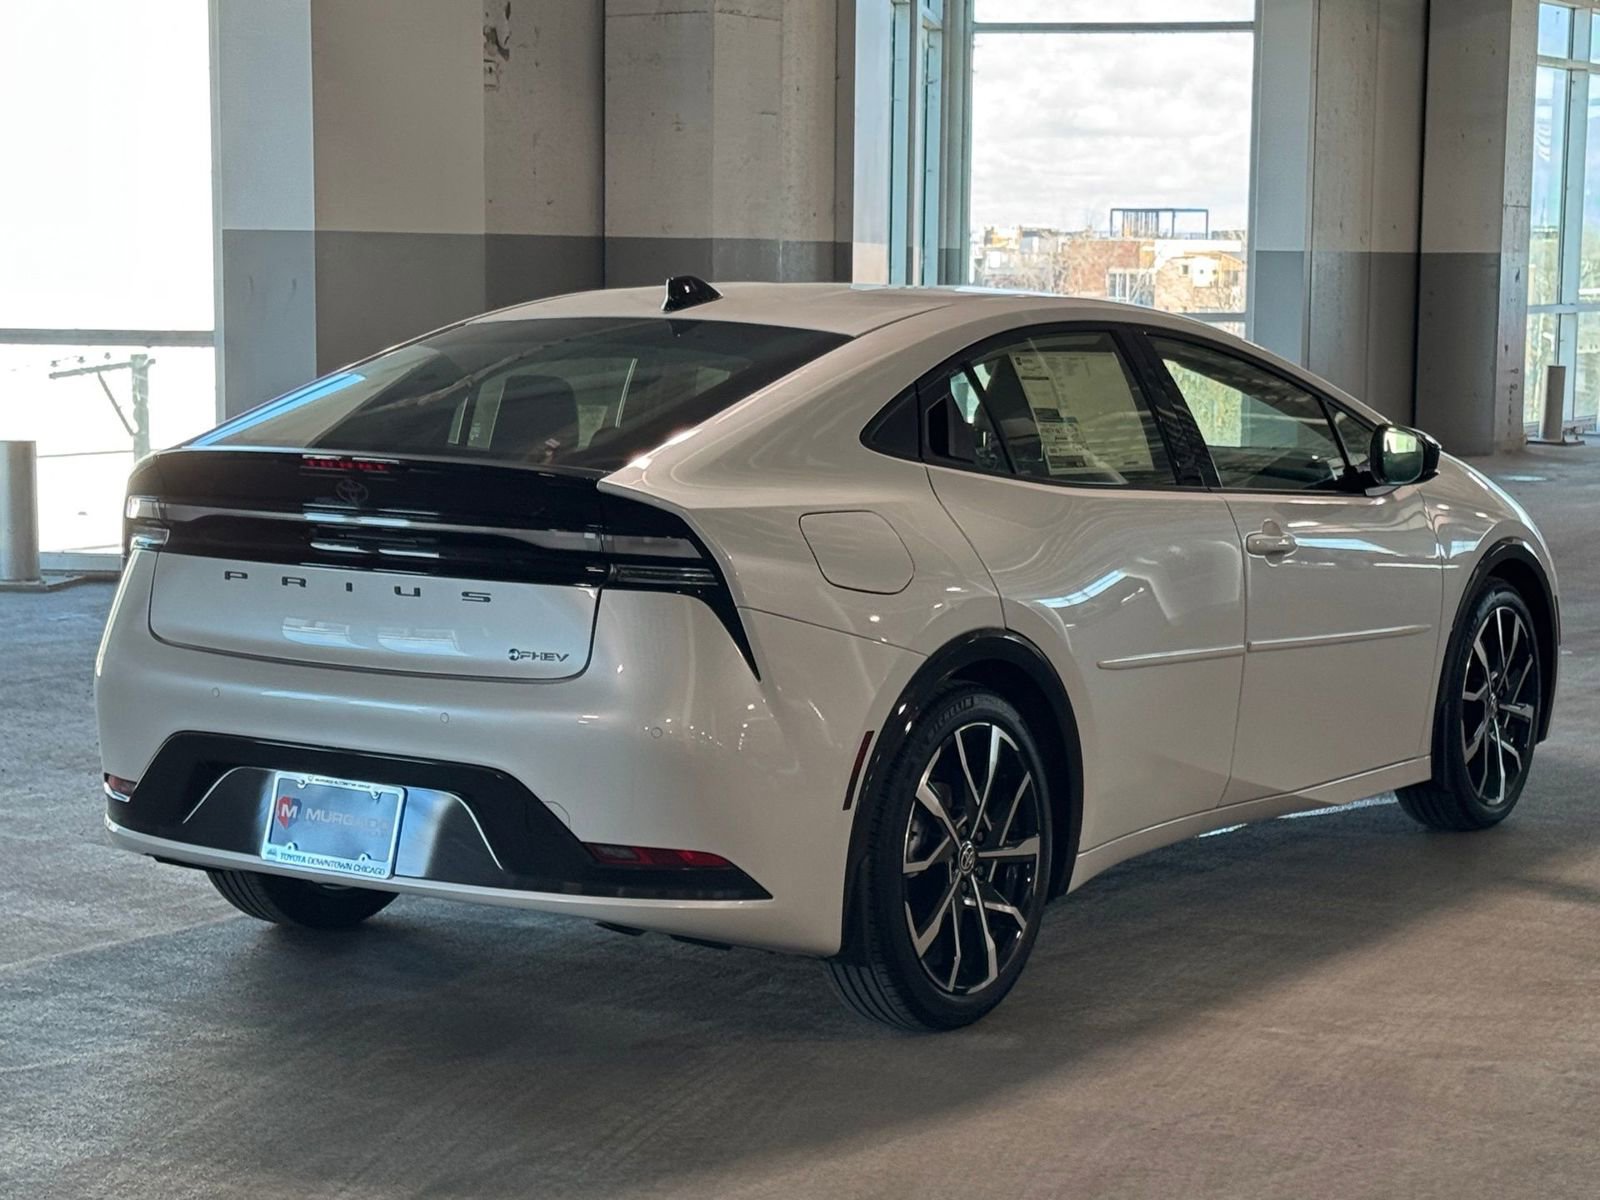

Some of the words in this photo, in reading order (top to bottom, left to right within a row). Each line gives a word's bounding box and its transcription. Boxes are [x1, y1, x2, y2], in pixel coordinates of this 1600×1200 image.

[224, 570, 491, 603] PRIUS
[520, 650, 570, 662] PHEV
[927, 695, 974, 742] MICHELIN
[281, 804, 298, 819] M
[305, 807, 389, 830] MURGD
[280, 853, 306, 864] TOYOTA
[307, 856, 352, 871] DOWNTOWN
[353, 864, 386, 876] CHICAGO
